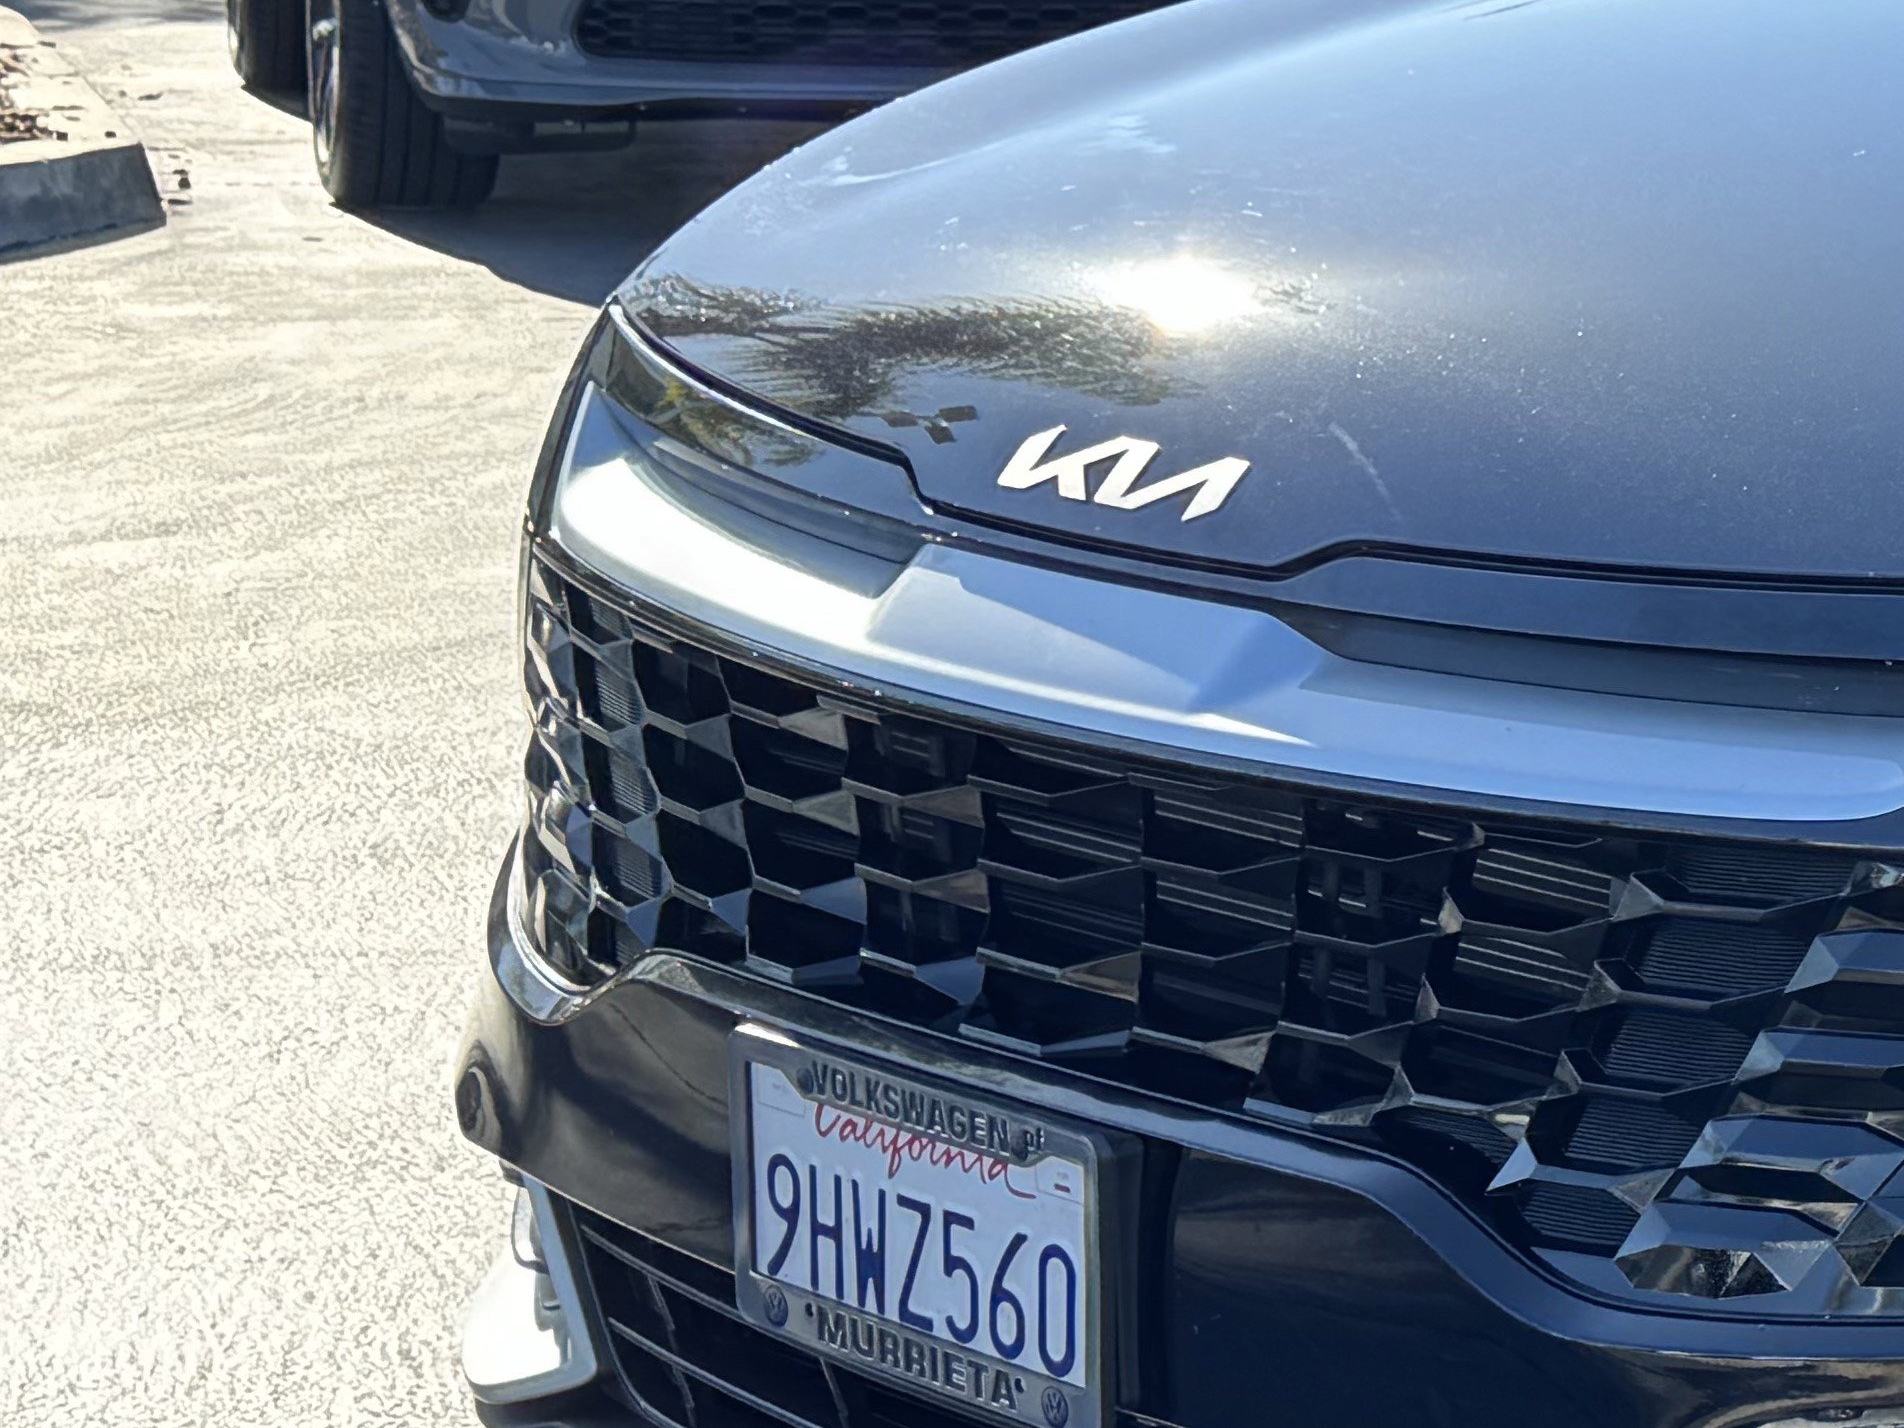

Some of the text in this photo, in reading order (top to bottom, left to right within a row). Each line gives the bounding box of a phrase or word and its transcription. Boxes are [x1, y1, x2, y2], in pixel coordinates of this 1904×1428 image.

[811, 1060, 1011, 1157] VOLKSWAGEN
[814, 1102, 1037, 1200] California
[767, 1153, 1077, 1378] 9HWZ560
[816, 1307, 1017, 1411] MURRIETA
